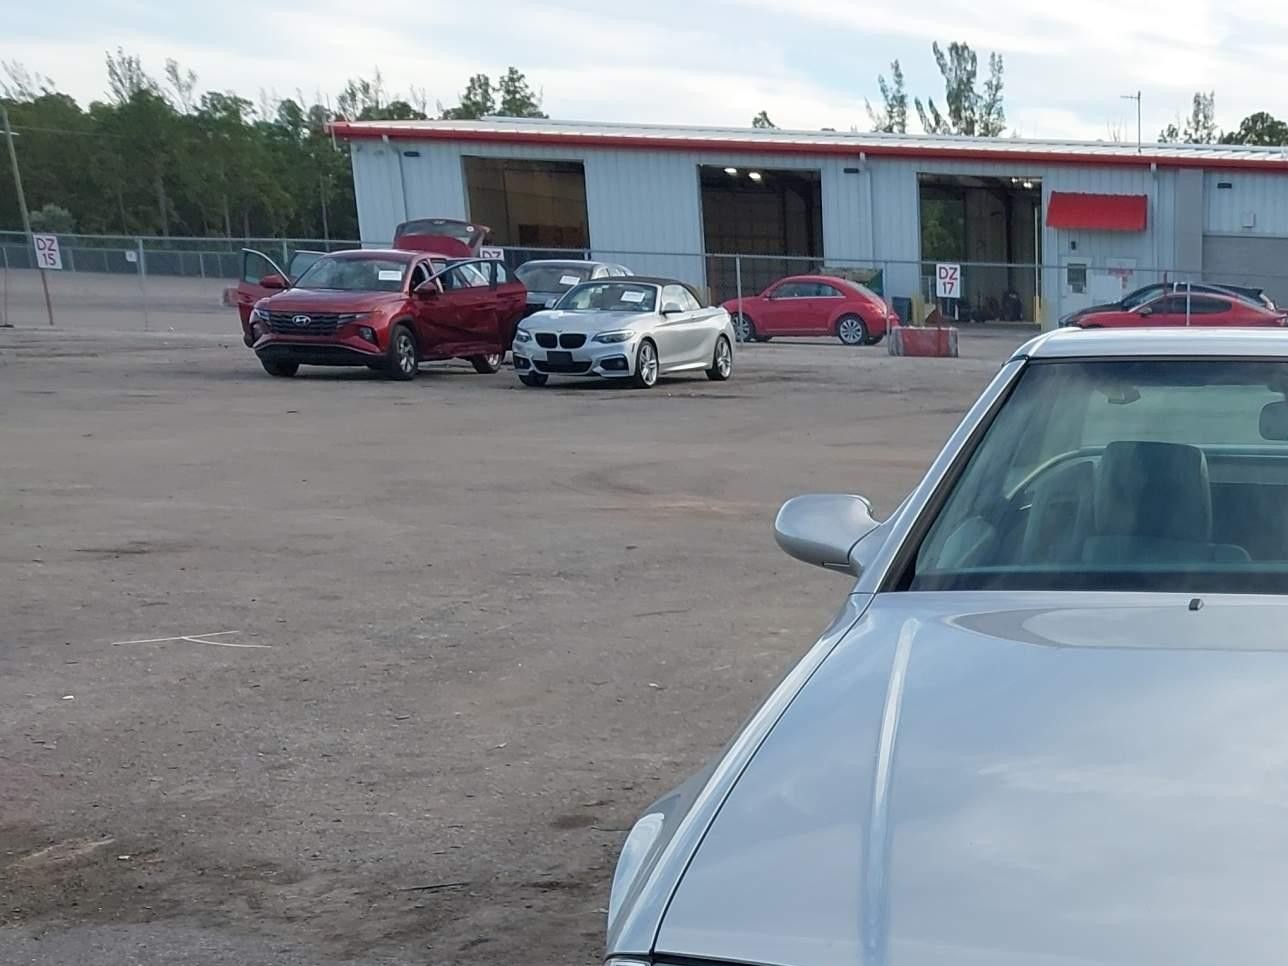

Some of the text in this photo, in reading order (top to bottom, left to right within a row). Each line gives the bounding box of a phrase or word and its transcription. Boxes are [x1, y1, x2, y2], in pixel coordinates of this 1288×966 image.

[36, 238, 56, 252] DZ
[42, 252, 56, 267] 15
[938, 266, 958, 280] DZ
[942, 281, 954, 295] 17
